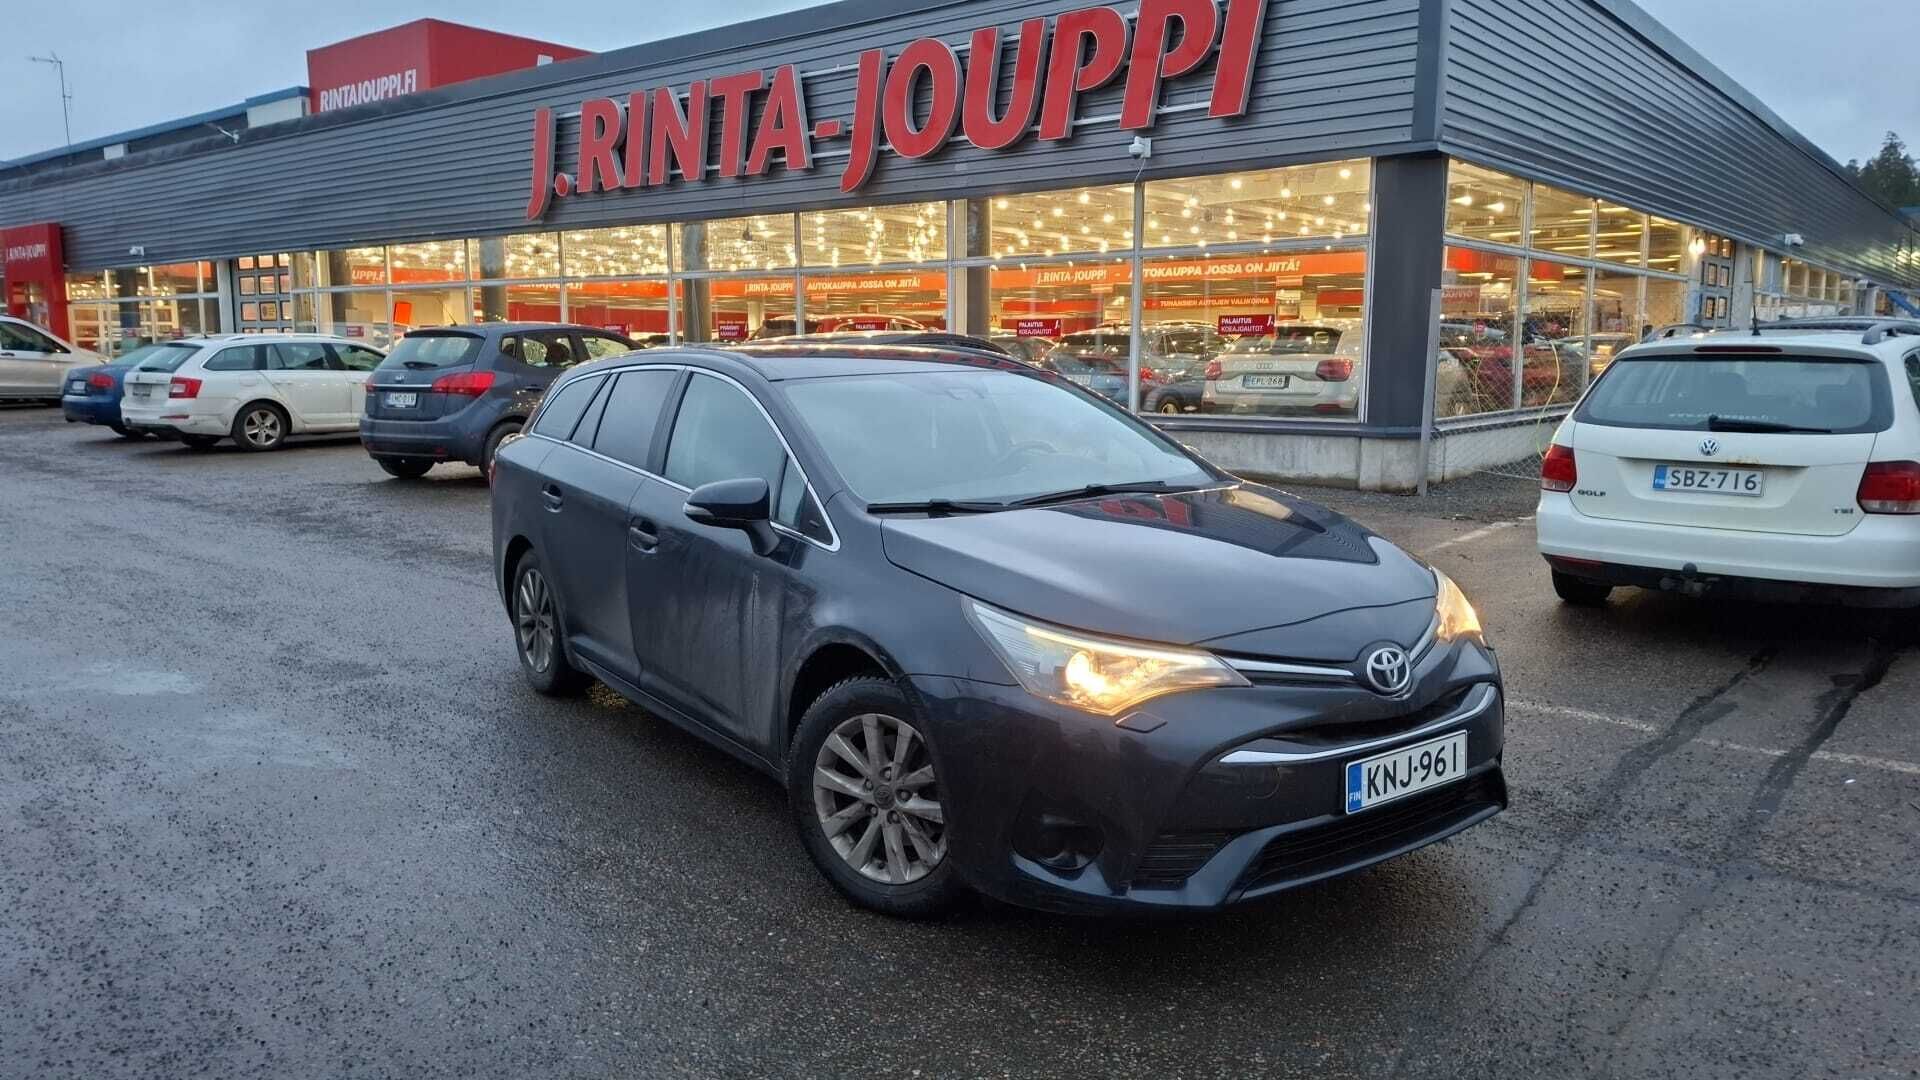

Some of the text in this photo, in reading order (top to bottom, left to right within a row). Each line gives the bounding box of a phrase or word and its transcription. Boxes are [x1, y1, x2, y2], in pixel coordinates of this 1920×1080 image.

[1205, 265, 1241, 276] JOSSA
[1245, 263, 1263, 273] ON
[352, 270, 385, 281] UPPI.F
[806, 280, 856, 290] AUTOKAUPPA
[859, 280, 882, 289] JOSSA
[885, 279, 897, 288] ON
[1221, 317, 1252, 325] PALAUTUS
[1670, 470, 1757, 491] SBZ-716
[1577, 489, 1606, 497] GOLF
[1367, 742, 1457, 800] KNJ-961
[1349, 790, 1361, 802] FIN
